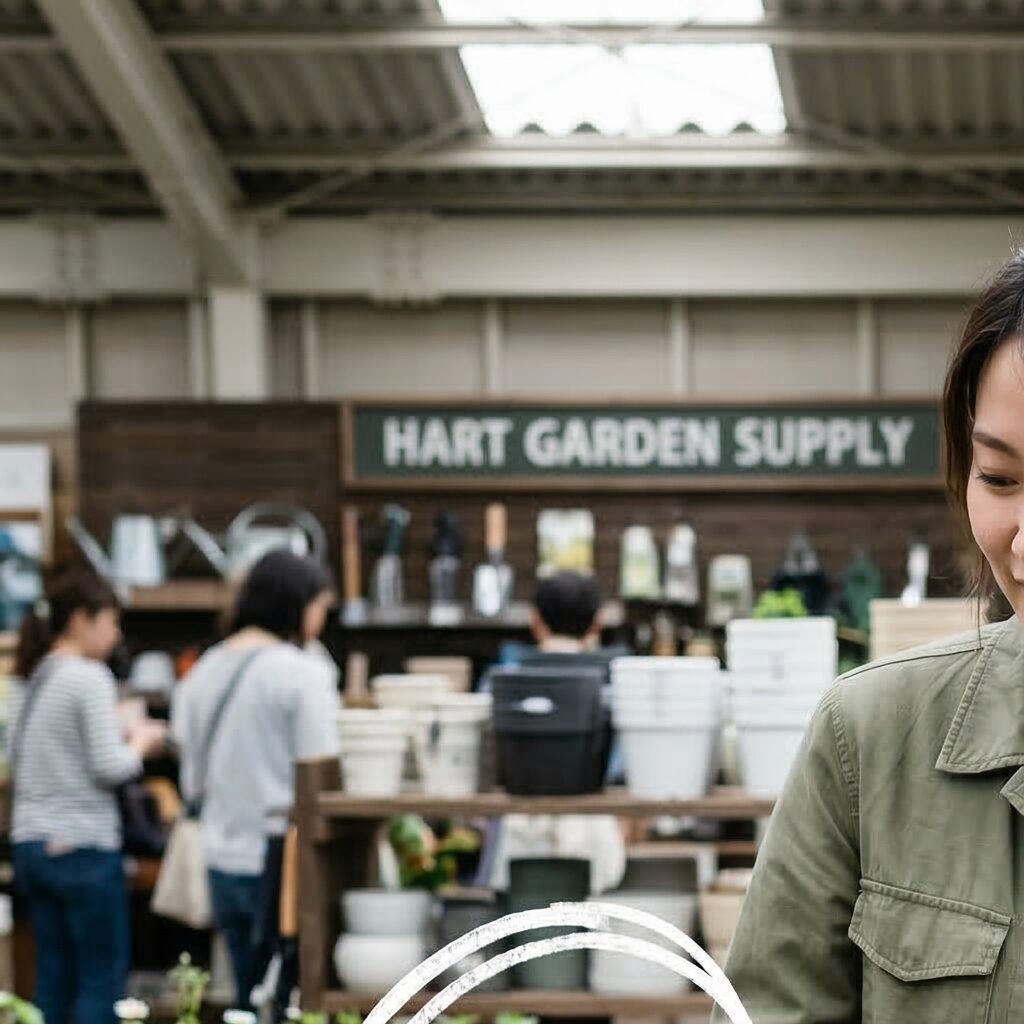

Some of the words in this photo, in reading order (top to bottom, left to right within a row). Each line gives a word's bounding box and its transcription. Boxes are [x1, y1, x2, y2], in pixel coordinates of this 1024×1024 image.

[382, 416, 512, 467] HART
[523, 417, 720, 467] GARDEN
[733, 417, 913, 467] SUPPLY
